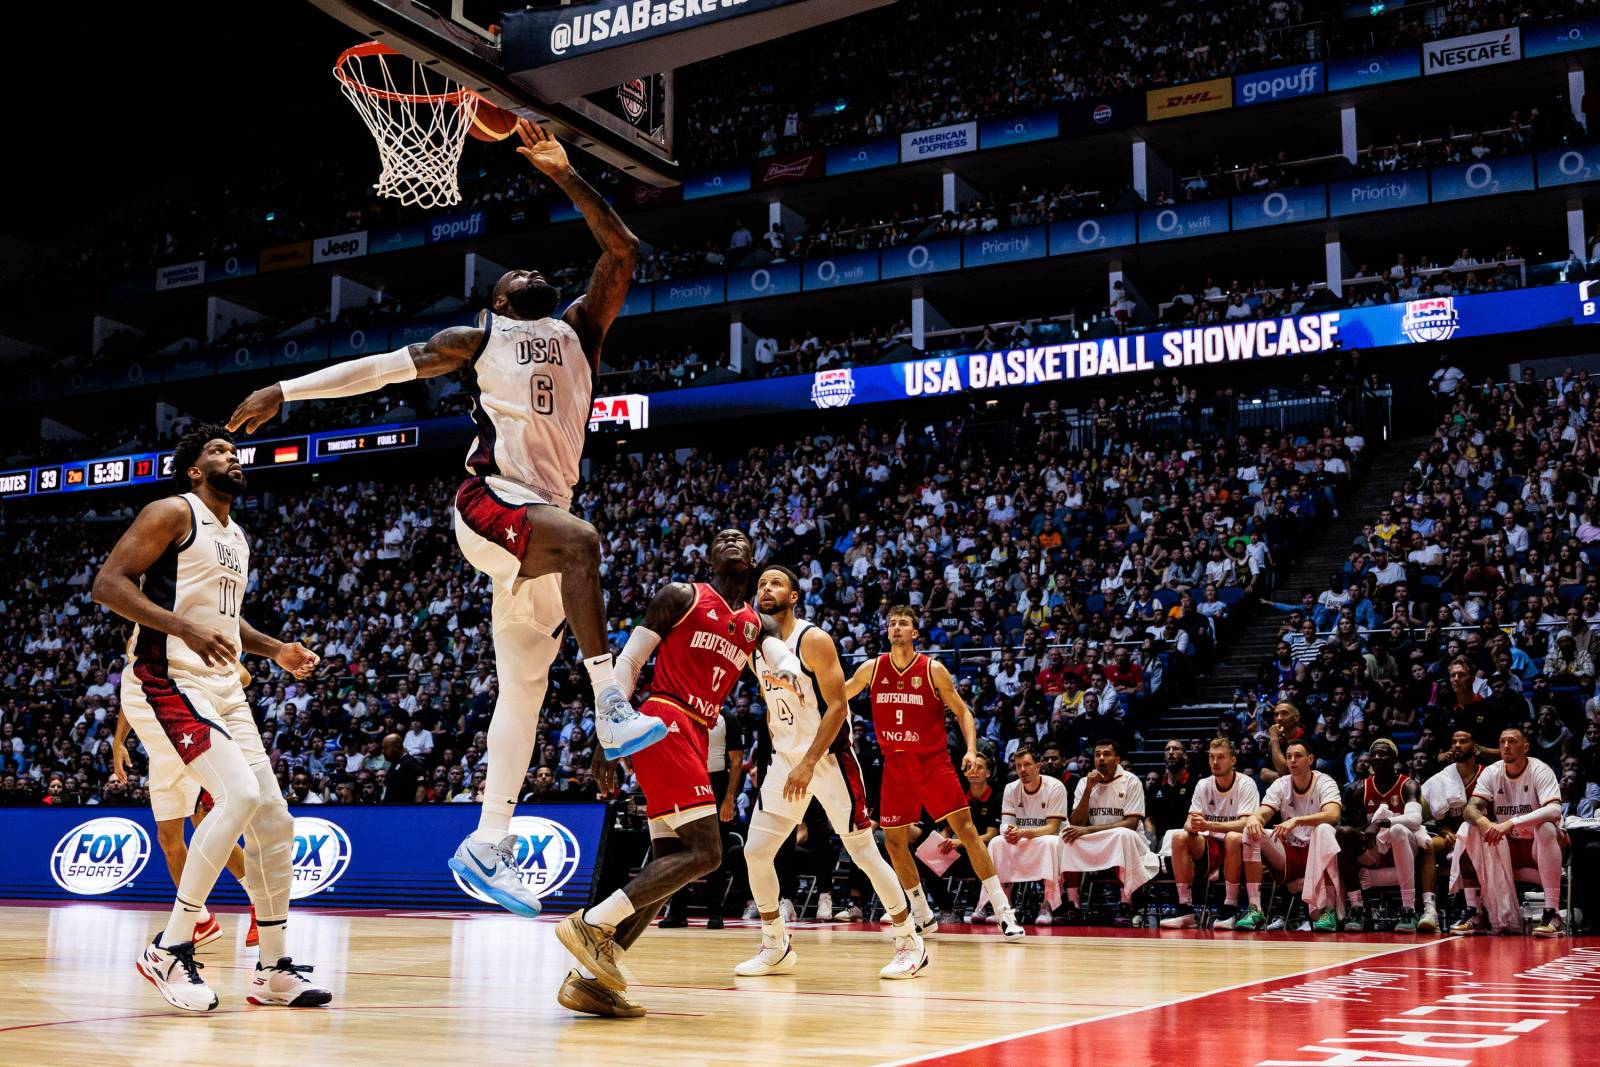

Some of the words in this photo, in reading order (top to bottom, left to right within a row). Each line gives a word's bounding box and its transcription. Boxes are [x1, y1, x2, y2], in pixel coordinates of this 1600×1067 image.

[550, 0, 749, 55] @USABaske
[1429, 34, 1511, 68] NESCAFÉ
[1243, 66, 1317, 102] gopuff
[1166, 91, 1211, 107] DHL
[911, 129, 967, 147] AMERICAN
[919, 139, 968, 154] EXPRESS
[1351, 183, 1406, 201] Priority
[431, 212, 482, 241] gopuff
[321, 239, 359, 256] Jeep
[982, 238, 1028, 255] Priority
[670, 284, 709, 300] Priority
[516, 338, 562, 366] USA
[905, 358, 962, 396] USA
[969, 335, 1154, 391] BASKETBALL
[1162, 312, 1341, 367] SHOWCASE
[530, 373, 553, 415] 6
[592, 399, 630, 418] SA
[327, 438, 356, 451] TIMEOUTS
[358, 437, 365, 448] 2
[377, 434, 397, 446] FOULS
[400, 433, 406, 443] 1
[94, 460, 124, 484] 5:39
[136, 460, 150, 476] 17
[162, 456, 177, 476] 2
[0, 474, 27, 493] TATES
[41, 470, 57, 489] 33
[214, 540, 242, 574] USA
[219, 576, 237, 618] 11
[689, 630, 748, 672] DEUTSCHLAND
[688, 694, 715, 717] ING
[876, 692, 924, 706] DEUTSCHLAND
[776, 698, 793, 726] 4
[895, 709, 903, 725] 9
[882, 730, 902, 742] ING
[72, 834, 134, 863] FOX
[291, 834, 330, 867] OX
[514, 835, 554, 869] OX
[67, 865, 123, 878] SPORTS
[293, 869, 322, 881] RTS
[516, 871, 548, 885] RTS
[1254, 993, 1595, 1067] ULTRA
